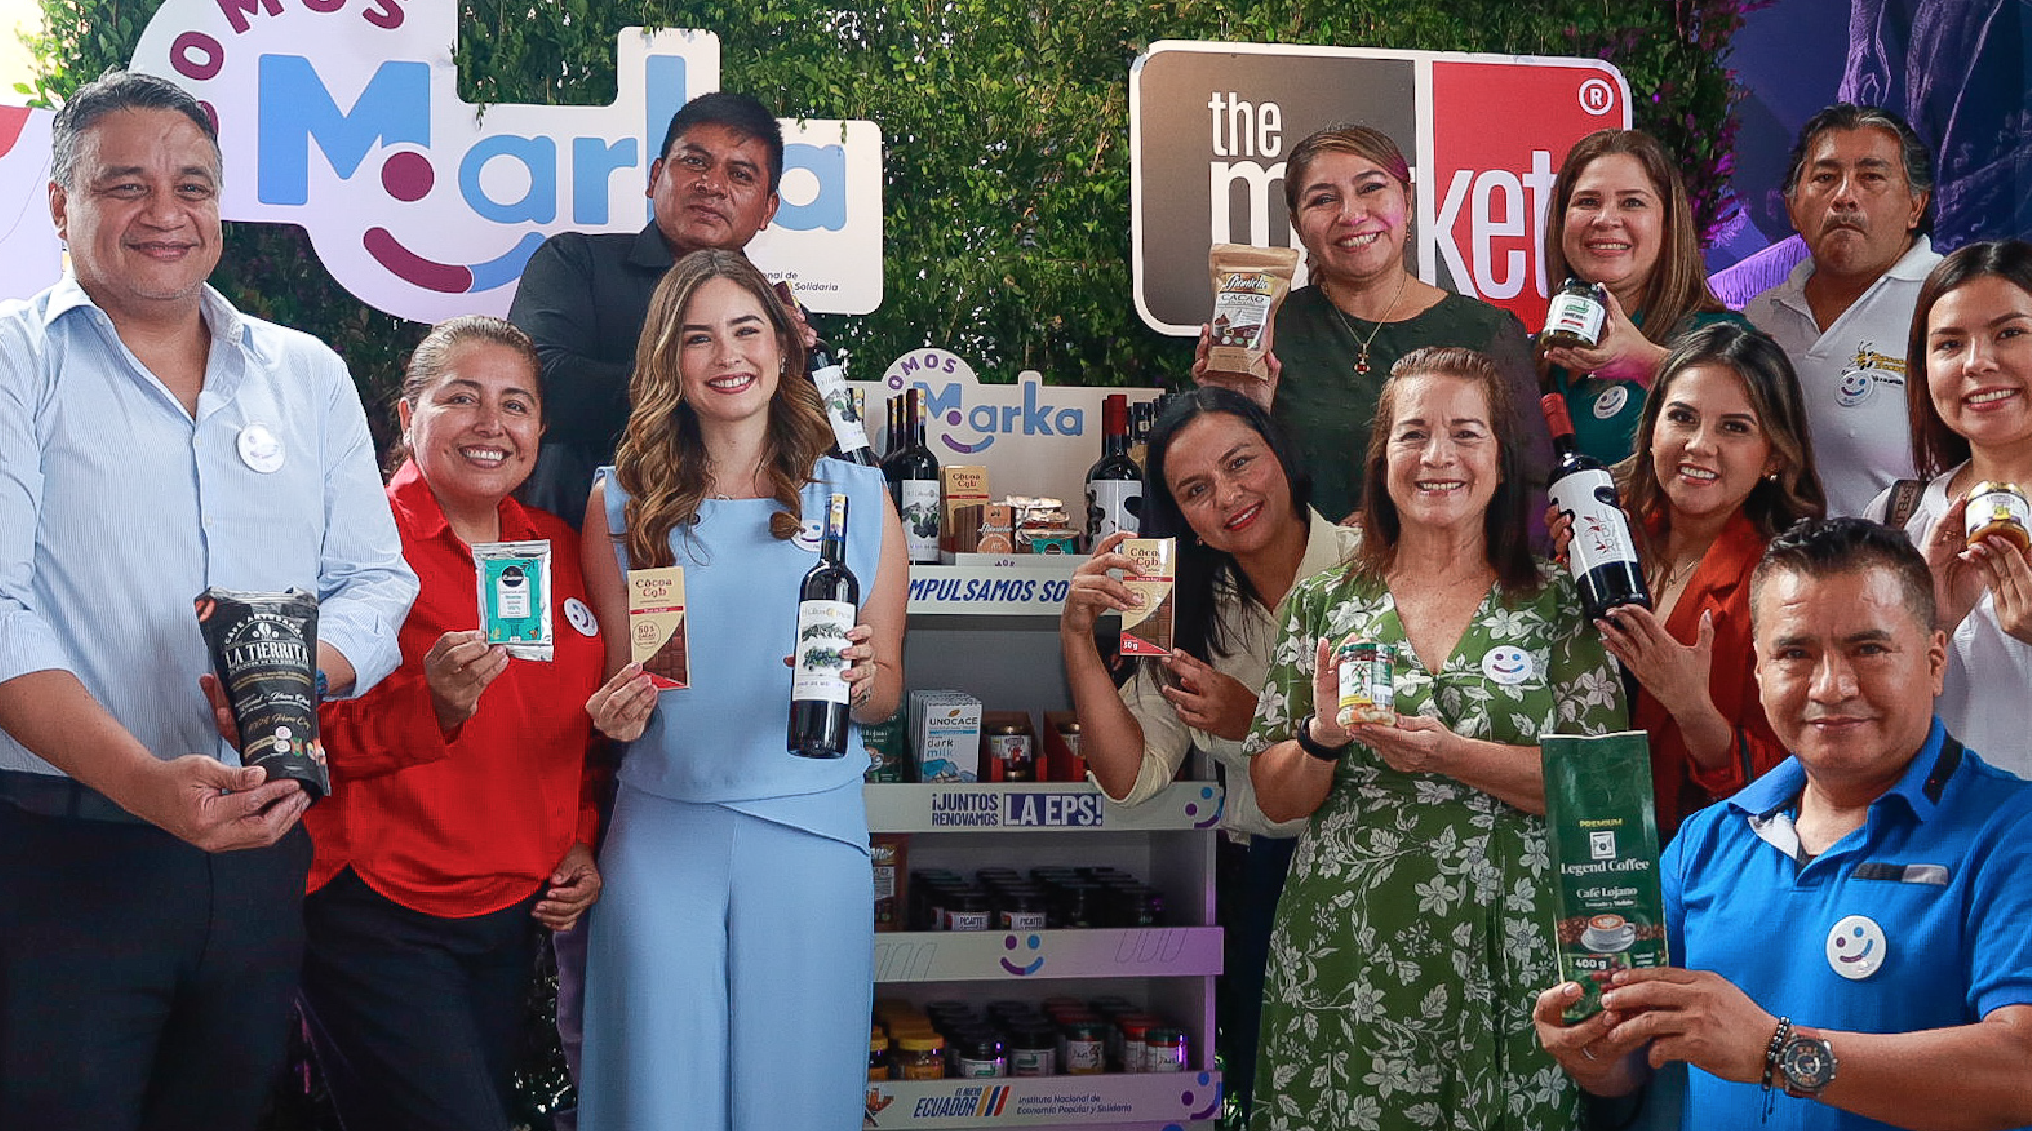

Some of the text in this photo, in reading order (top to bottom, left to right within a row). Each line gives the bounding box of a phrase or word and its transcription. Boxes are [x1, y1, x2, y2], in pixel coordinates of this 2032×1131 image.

[1208, 91, 1283, 157] the
[1211, 150, 1557, 300] mket
[912, 381, 1084, 436] Marka
[908, 578, 1036, 602] MPULSAMOS
[226, 647, 243, 669] LA
[245, 641, 310, 667] TIERRITA
[927, 739, 954, 748] dark
[931, 793, 999, 811] ¡JUNTOS
[1004, 794, 1102, 826] LA EPS!
[931, 812, 999, 827] RENOVAMOS
[1560, 858, 1650, 876] Legend Coffee
[1576, 886, 1638, 899] Café Lojano
[1575, 958, 1597, 969] 400
[913, 1096, 978, 1118] ECUADOR
[1054, 1093, 1089, 1103] Nacional
[1090, 1095, 1101, 1103] de
[1057, 1105, 1089, 1115] Popular
